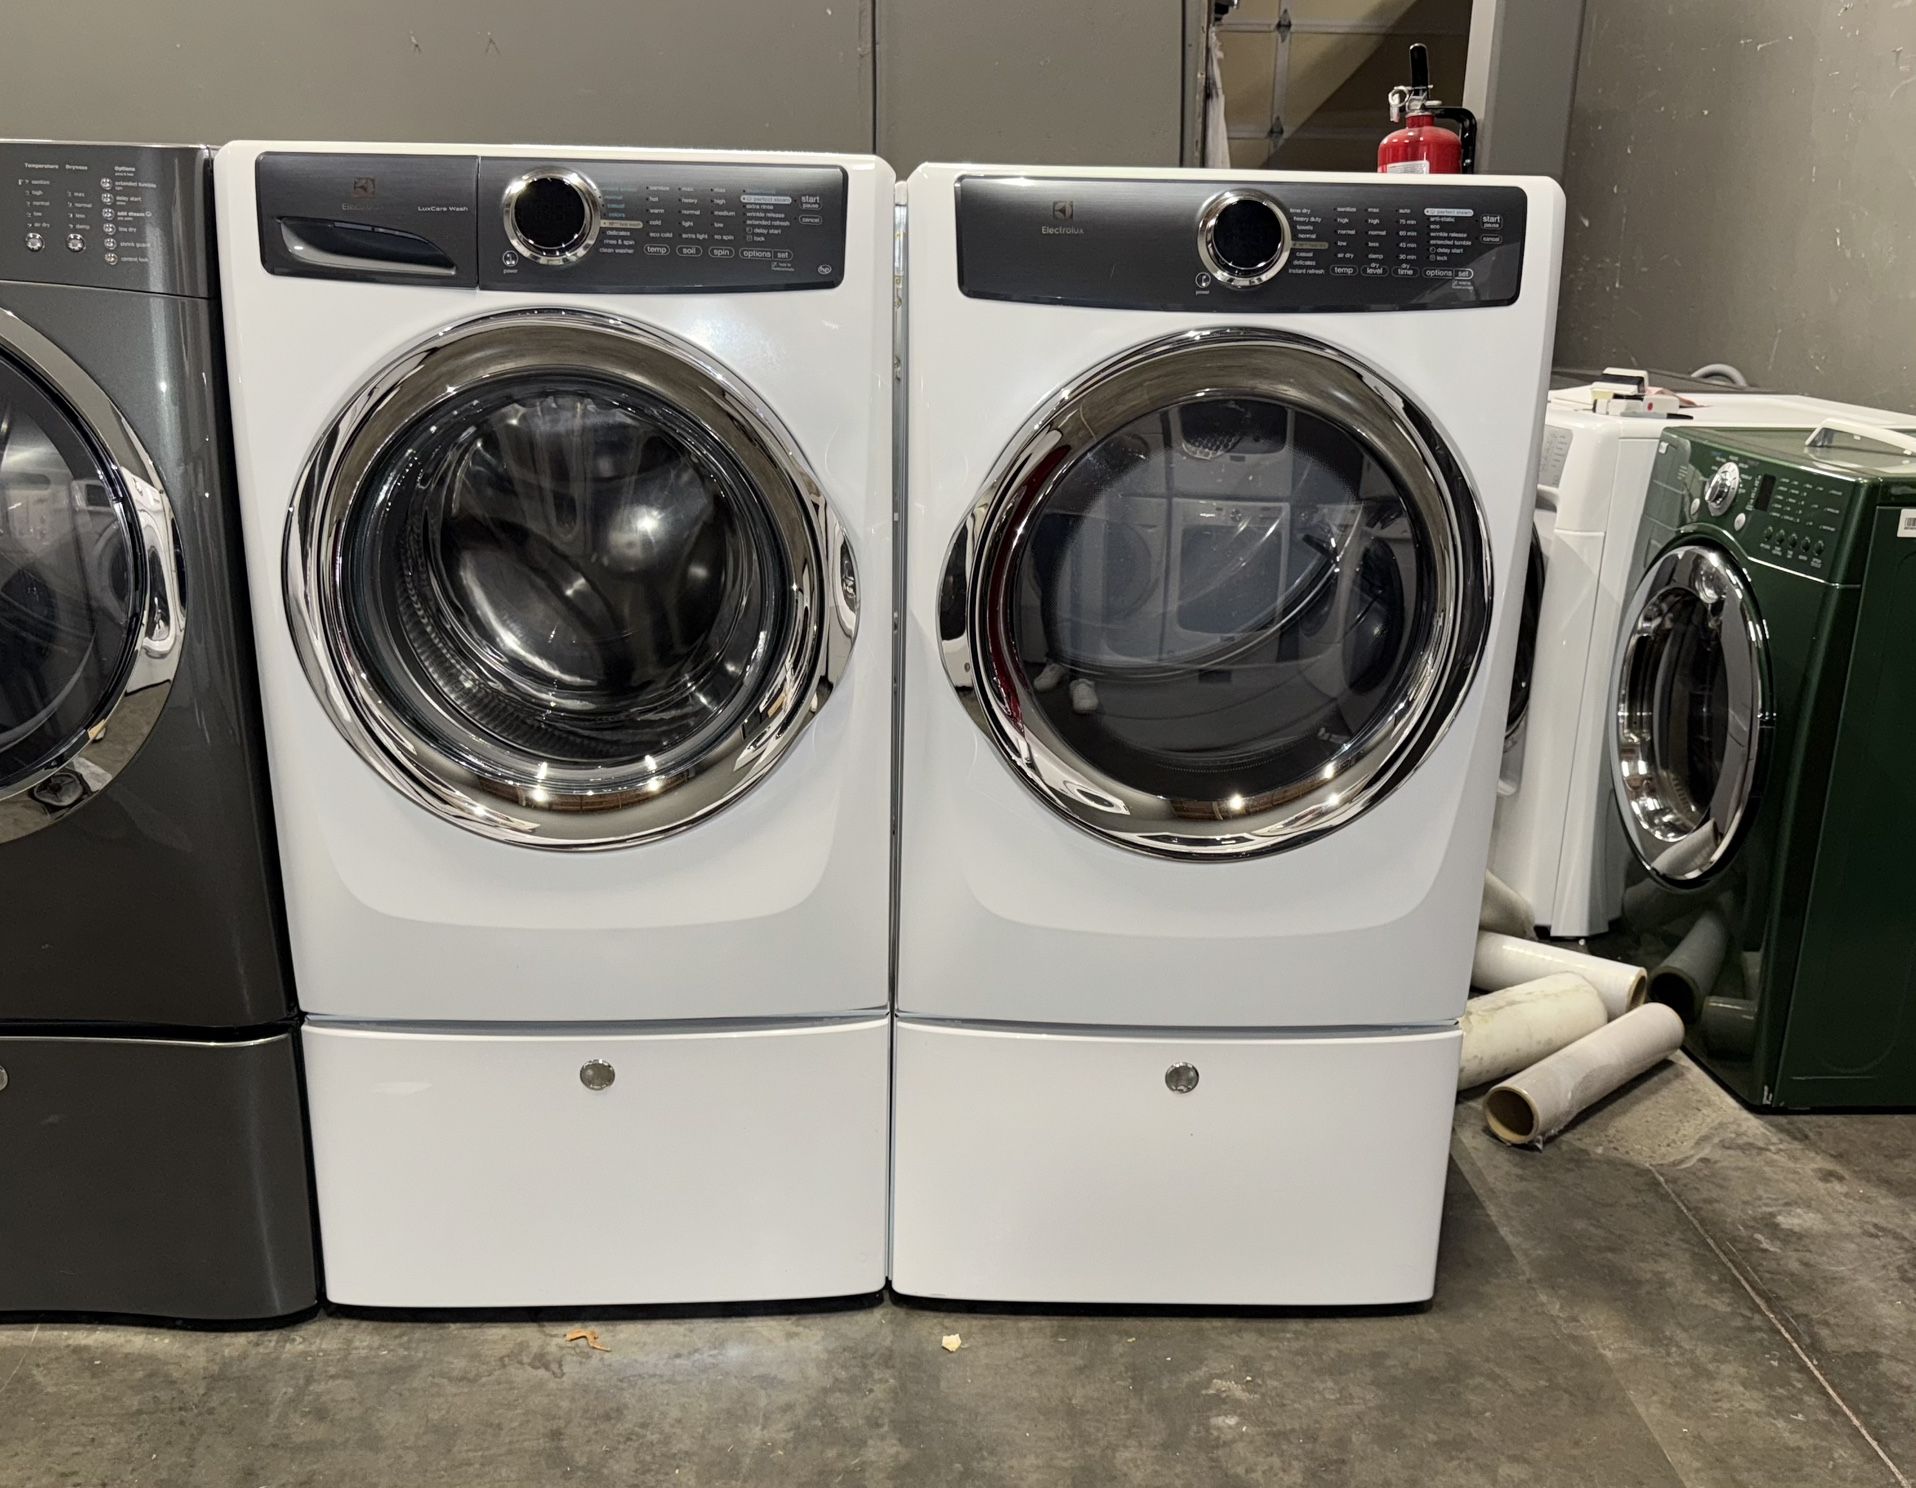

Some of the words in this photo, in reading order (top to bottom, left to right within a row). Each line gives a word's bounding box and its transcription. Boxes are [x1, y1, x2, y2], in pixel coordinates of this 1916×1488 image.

[801, 195, 820, 203] start
[1482, 215, 1501, 223] start
[1041, 225, 1085, 235] Electrolux
[646, 246, 667, 254] temp
[713, 248, 730, 257] spin
[743, 250, 771, 259] options
[1334, 266, 1354, 275] temp
[1366, 267, 1383, 275] level
[1397, 268, 1414, 276] time
[1425, 268, 1453, 278] options
